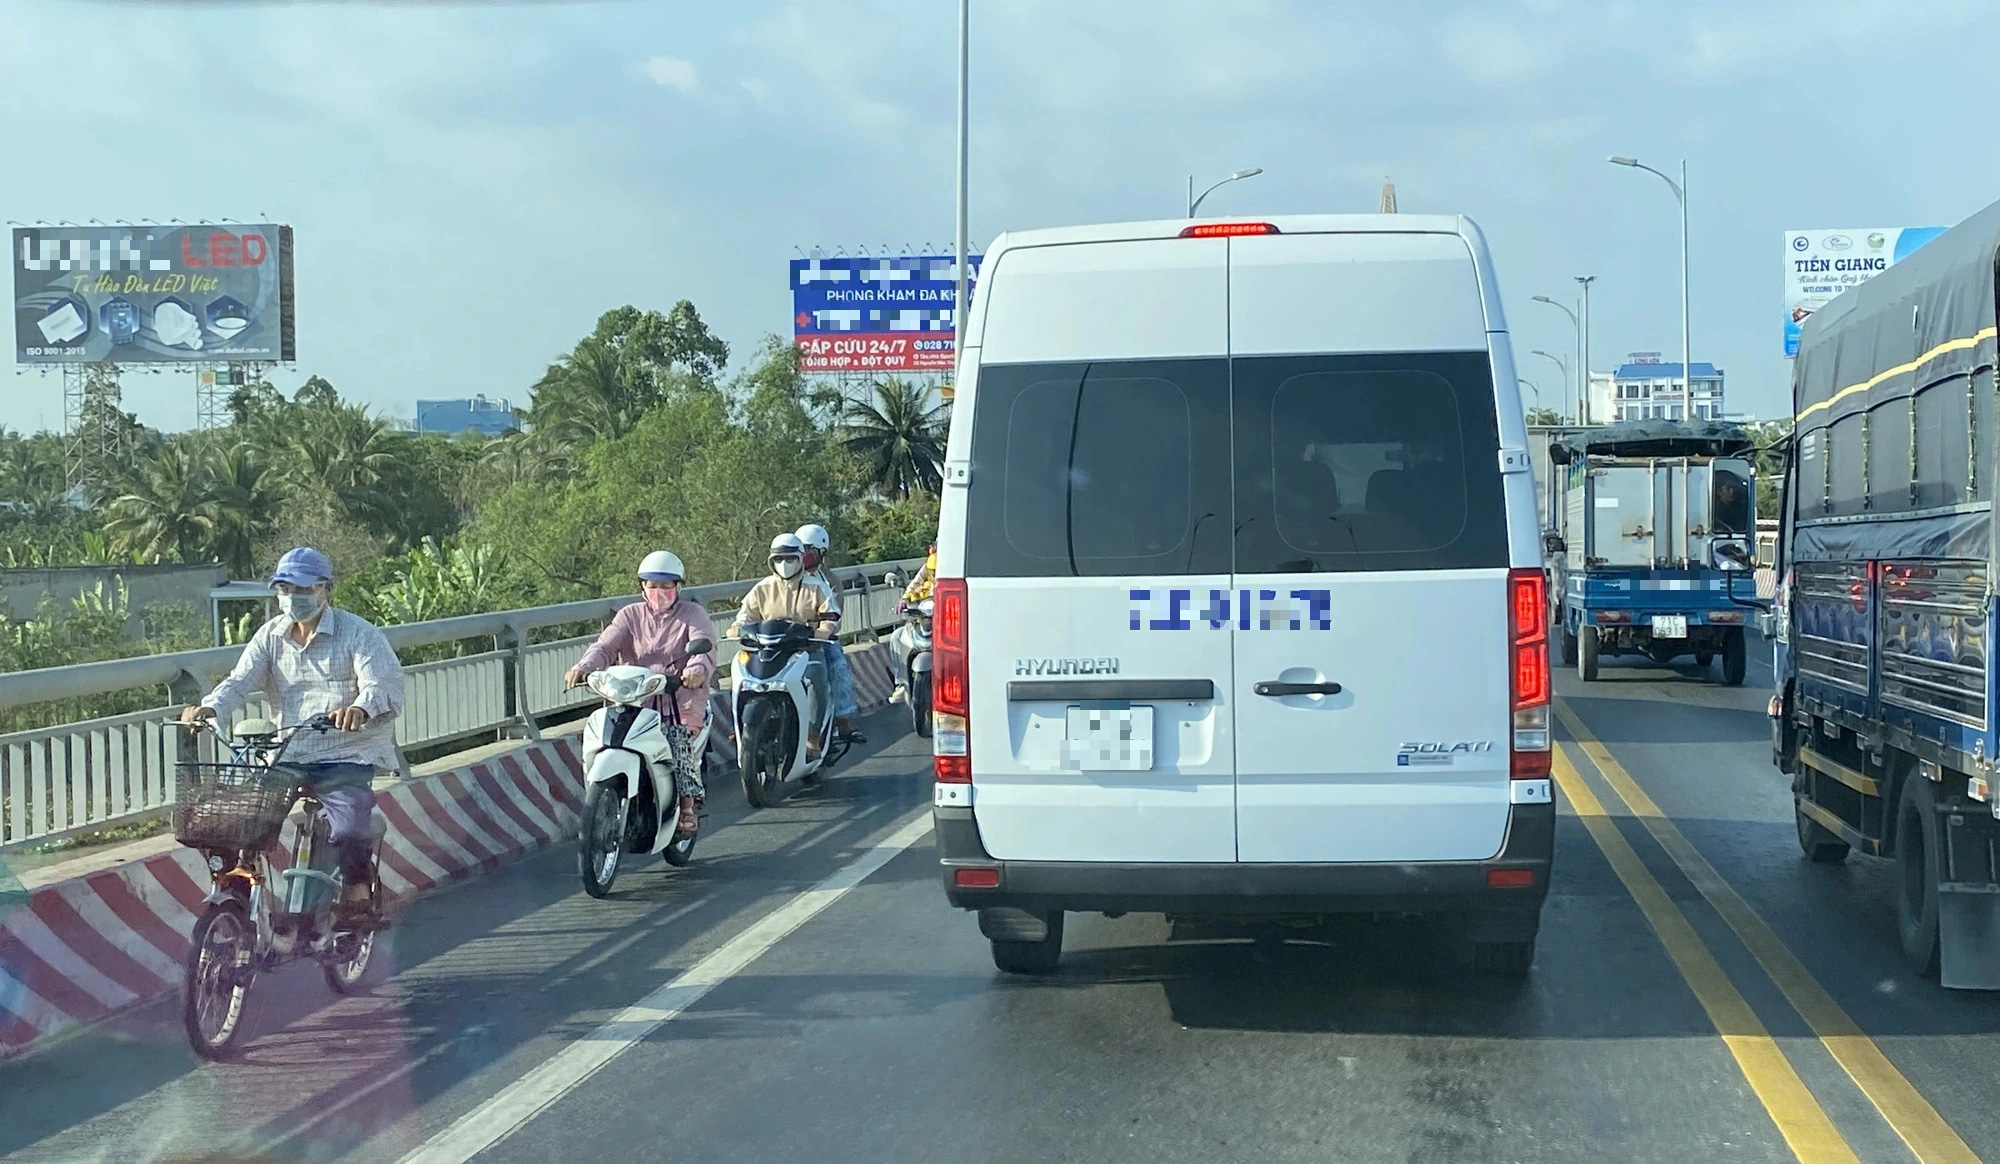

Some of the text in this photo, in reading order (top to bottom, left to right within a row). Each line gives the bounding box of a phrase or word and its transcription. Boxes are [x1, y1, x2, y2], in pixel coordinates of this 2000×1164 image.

[181, 232, 267, 268] LED
[1795, 255, 1886, 272] TIỀN GIANG
[94, 274, 120, 294] Hào
[153, 273, 186, 294] LED
[190, 273, 219, 296] Việt
[919, 289, 938, 301] ĐA
[26, 347, 42, 356] ISO
[869, 339, 907, 355] 24/7
[923, 340, 956, 350] 028 71
[1014, 657, 1120, 676] HYUNDAI
[1398, 740, 1493, 754] SOLATI
